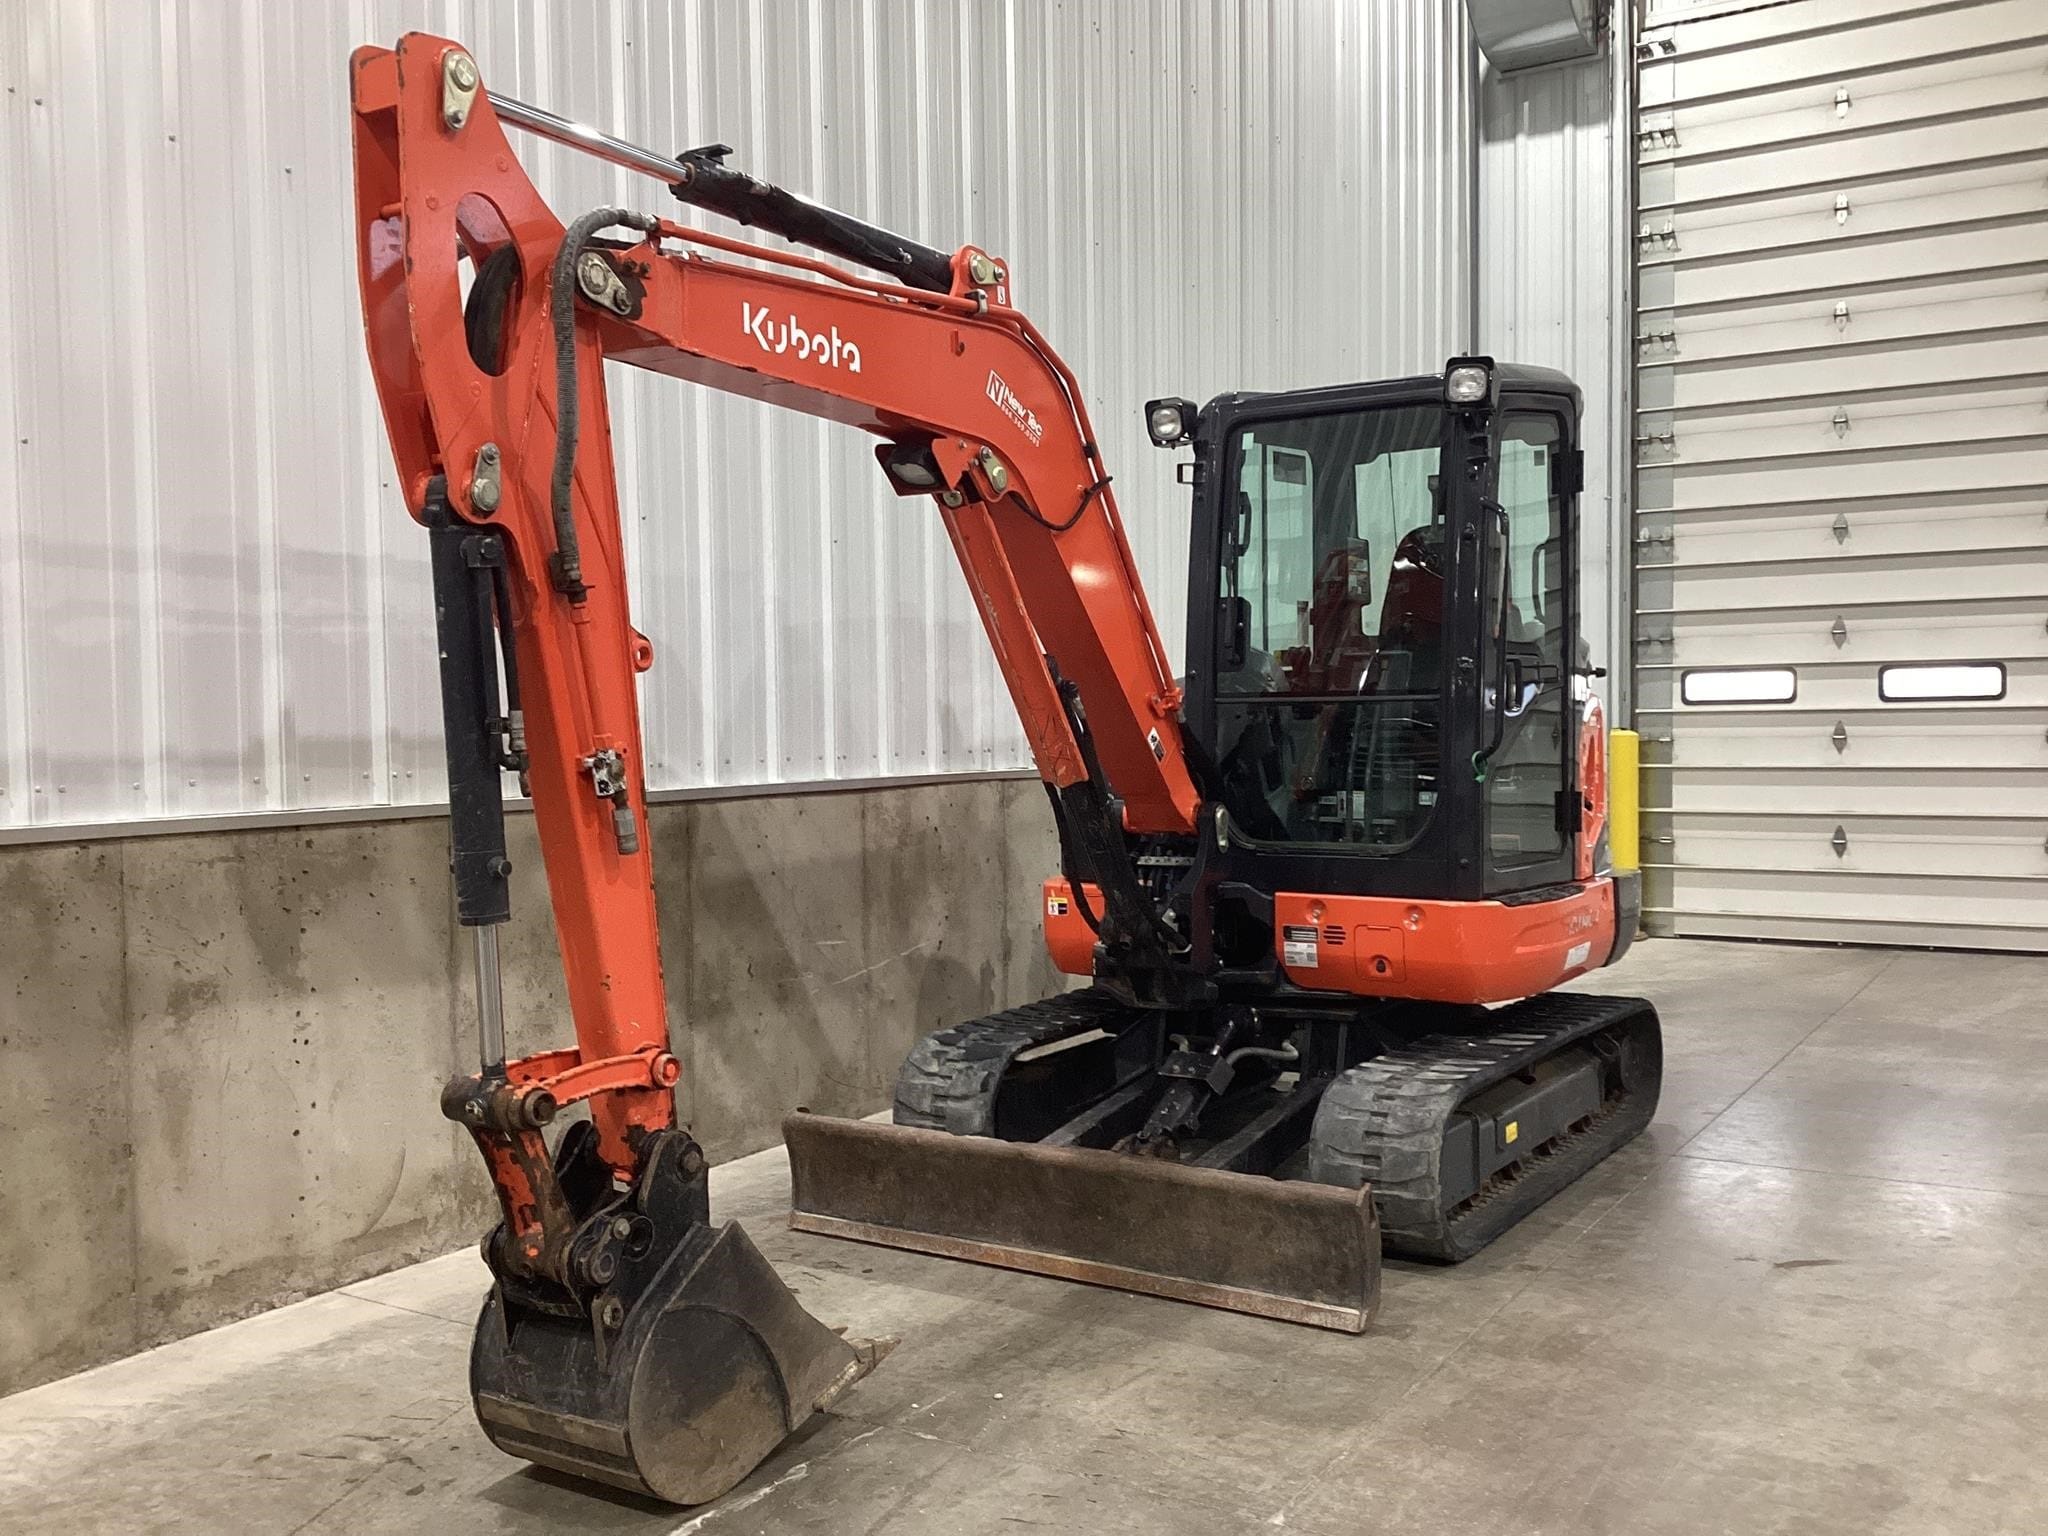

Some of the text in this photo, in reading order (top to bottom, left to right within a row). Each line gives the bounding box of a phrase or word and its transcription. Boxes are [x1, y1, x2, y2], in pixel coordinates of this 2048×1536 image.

[743, 301, 861, 373] Kubota
[1004, 386, 1027, 417] New
[1027, 409, 1043, 437] Tec
